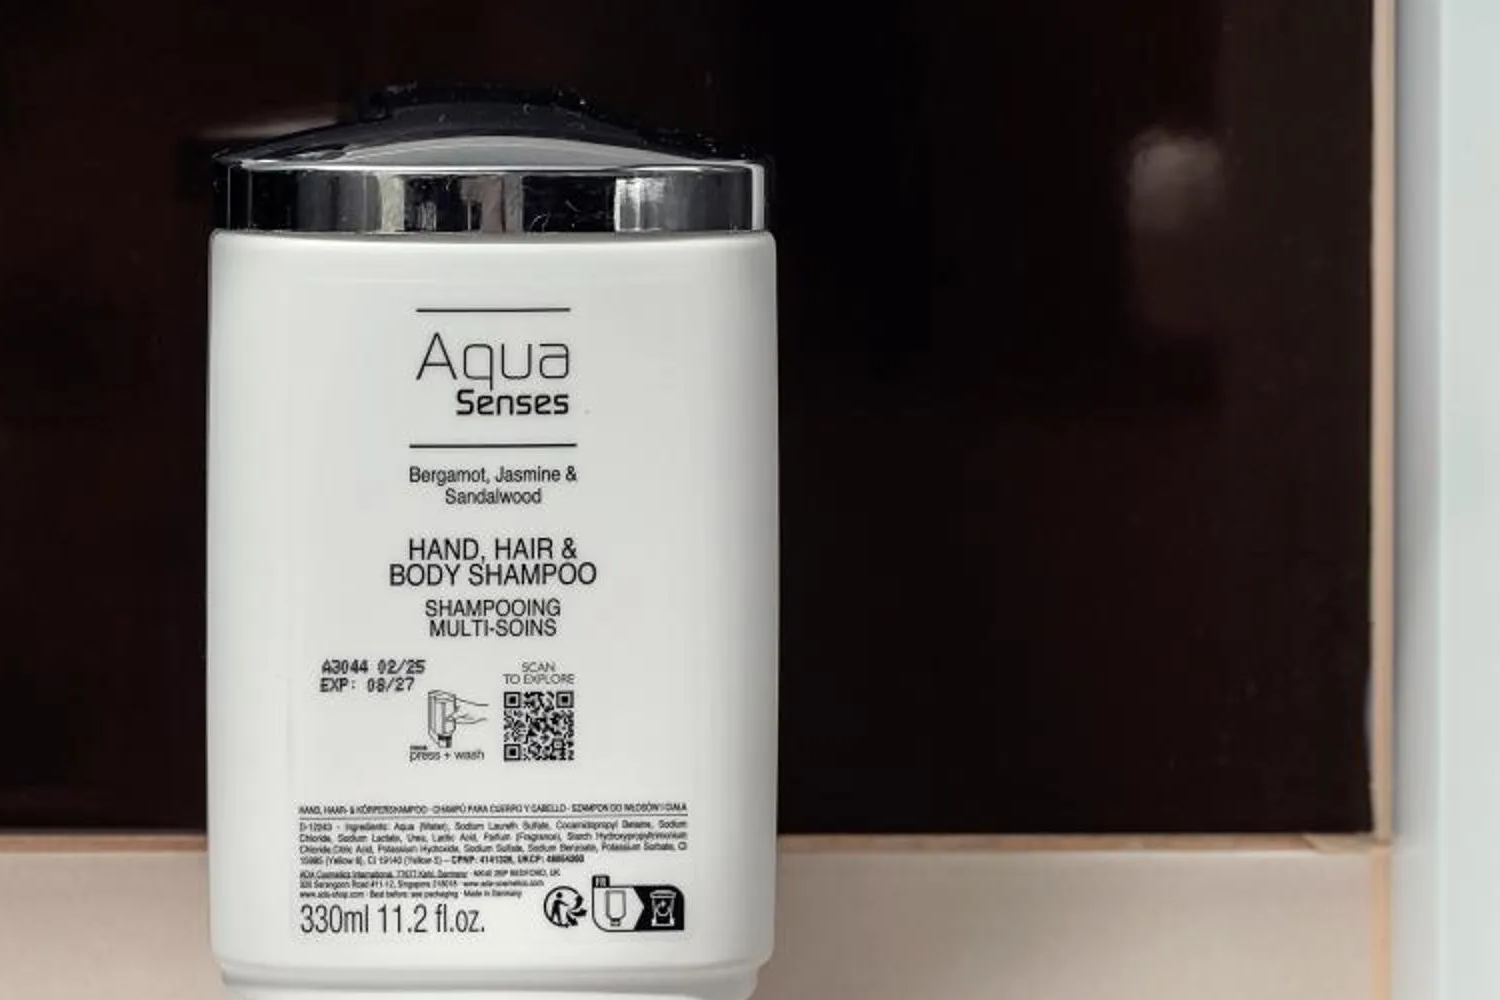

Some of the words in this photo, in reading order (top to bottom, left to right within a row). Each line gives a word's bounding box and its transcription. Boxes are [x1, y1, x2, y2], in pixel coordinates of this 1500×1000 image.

[416, 332, 571, 391] Aqua
[456, 389, 570, 416] Senses
[409, 466, 490, 486] Bergamot,
[494, 465, 561, 483] Jasmine
[565, 465, 578, 483] &
[445, 487, 542, 505] Sandalwood
[409, 537, 486, 563] HAND,
[494, 537, 554, 561] HAIR
[562, 537, 578, 561] &
[389, 563, 460, 588] BODY
[468, 562, 597, 587] SHAMPOO
[425, 598, 561, 618] SHAMPOOING
[429, 619, 557, 638] MULTI-SOINS
[321, 658, 369, 675] A3044
[377, 658, 426, 675] 02/25
[522, 661, 556, 672] SCAN
[319, 677, 356, 693] EXP:
[502, 673, 521, 685] TO
[523, 673, 575, 685] EXPLORE
[409, 751, 441, 763] press
[453, 750, 485, 761] wash
[300, 902, 369, 934] 330ml
[377, 903, 428, 933] 11.2
[435, 903, 485, 933] fl.oz.
